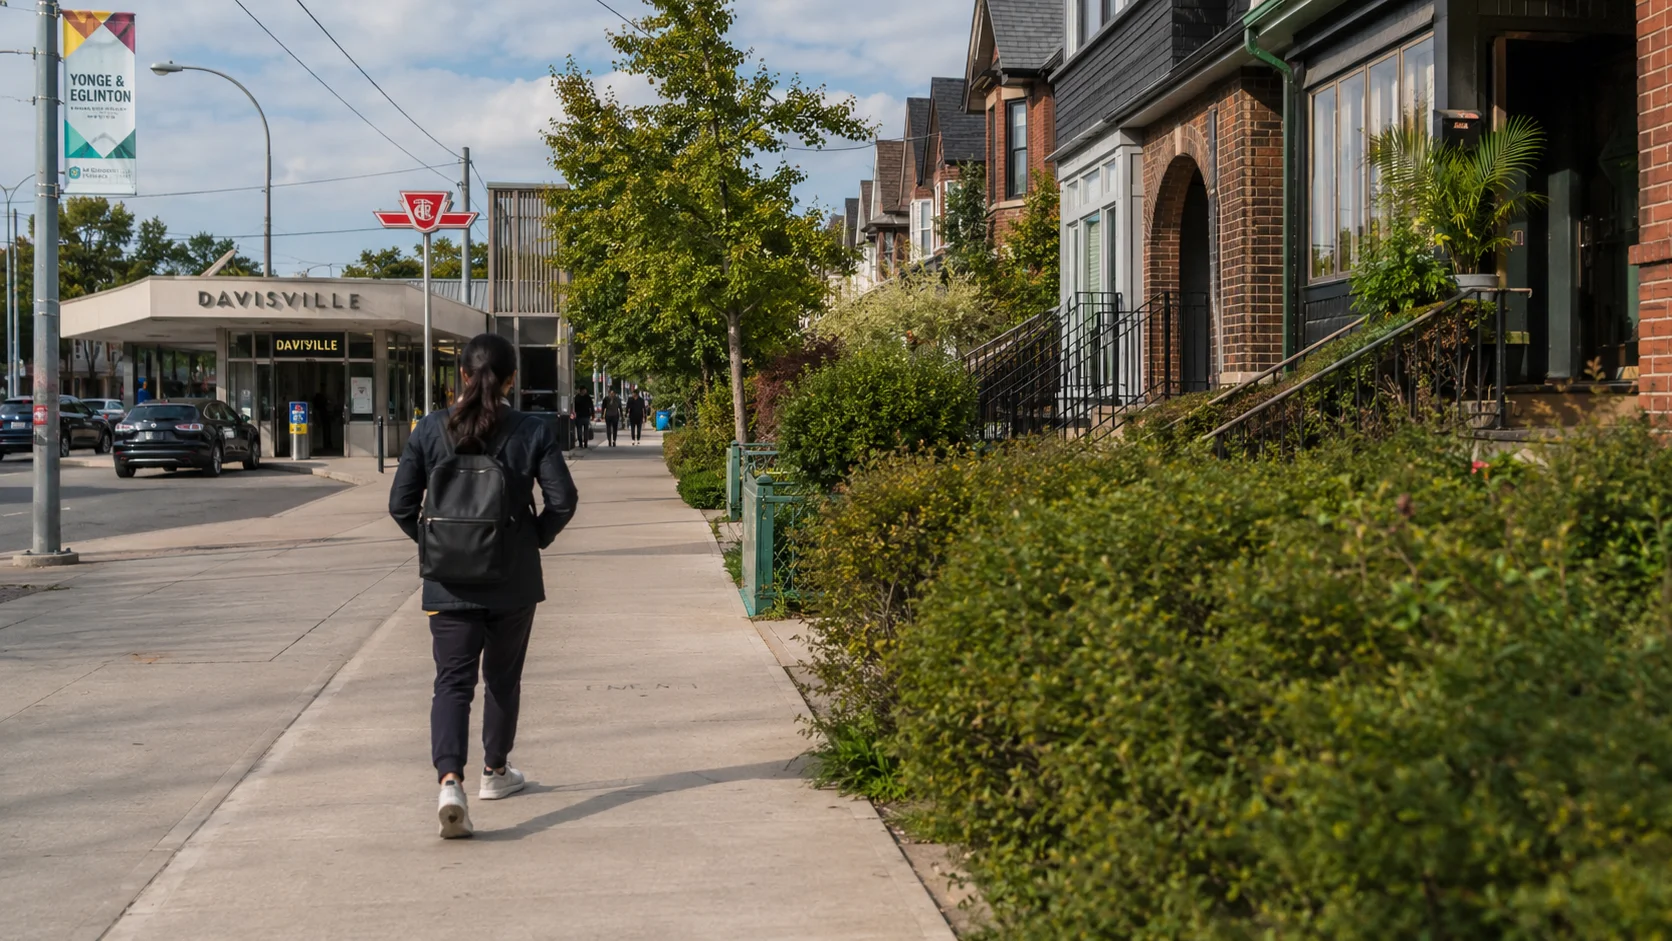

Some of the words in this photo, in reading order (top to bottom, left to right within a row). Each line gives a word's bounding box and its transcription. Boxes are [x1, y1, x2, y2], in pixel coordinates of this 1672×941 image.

[70, 73, 112, 87] YONGE
[116, 75, 125, 87] &
[70, 89, 131, 103] EGLINTON
[198, 290, 361, 310] DAVISVILLE
